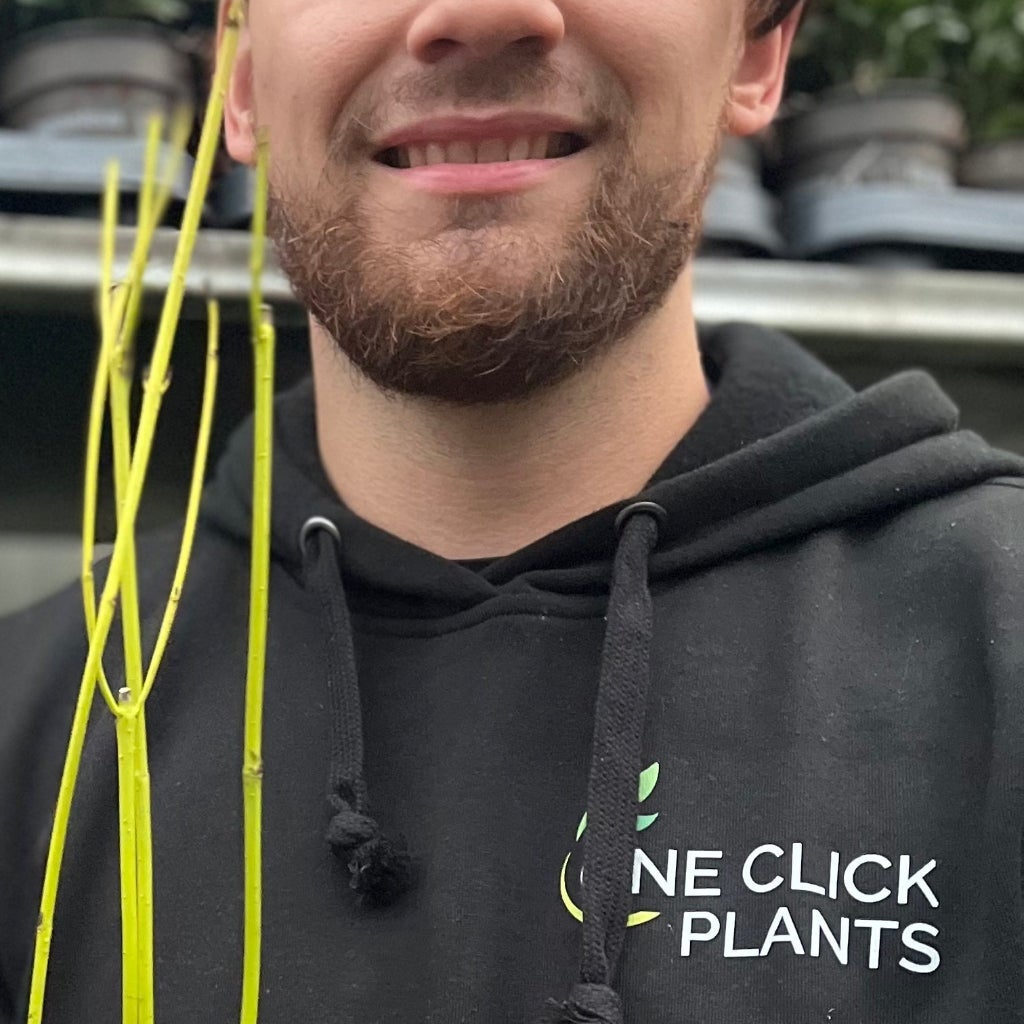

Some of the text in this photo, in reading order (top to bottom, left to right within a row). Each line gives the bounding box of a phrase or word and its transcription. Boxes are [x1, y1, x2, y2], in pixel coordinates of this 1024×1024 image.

[579, 842, 939, 908] NE CLICK
[680, 906, 941, 974] PLANTS
